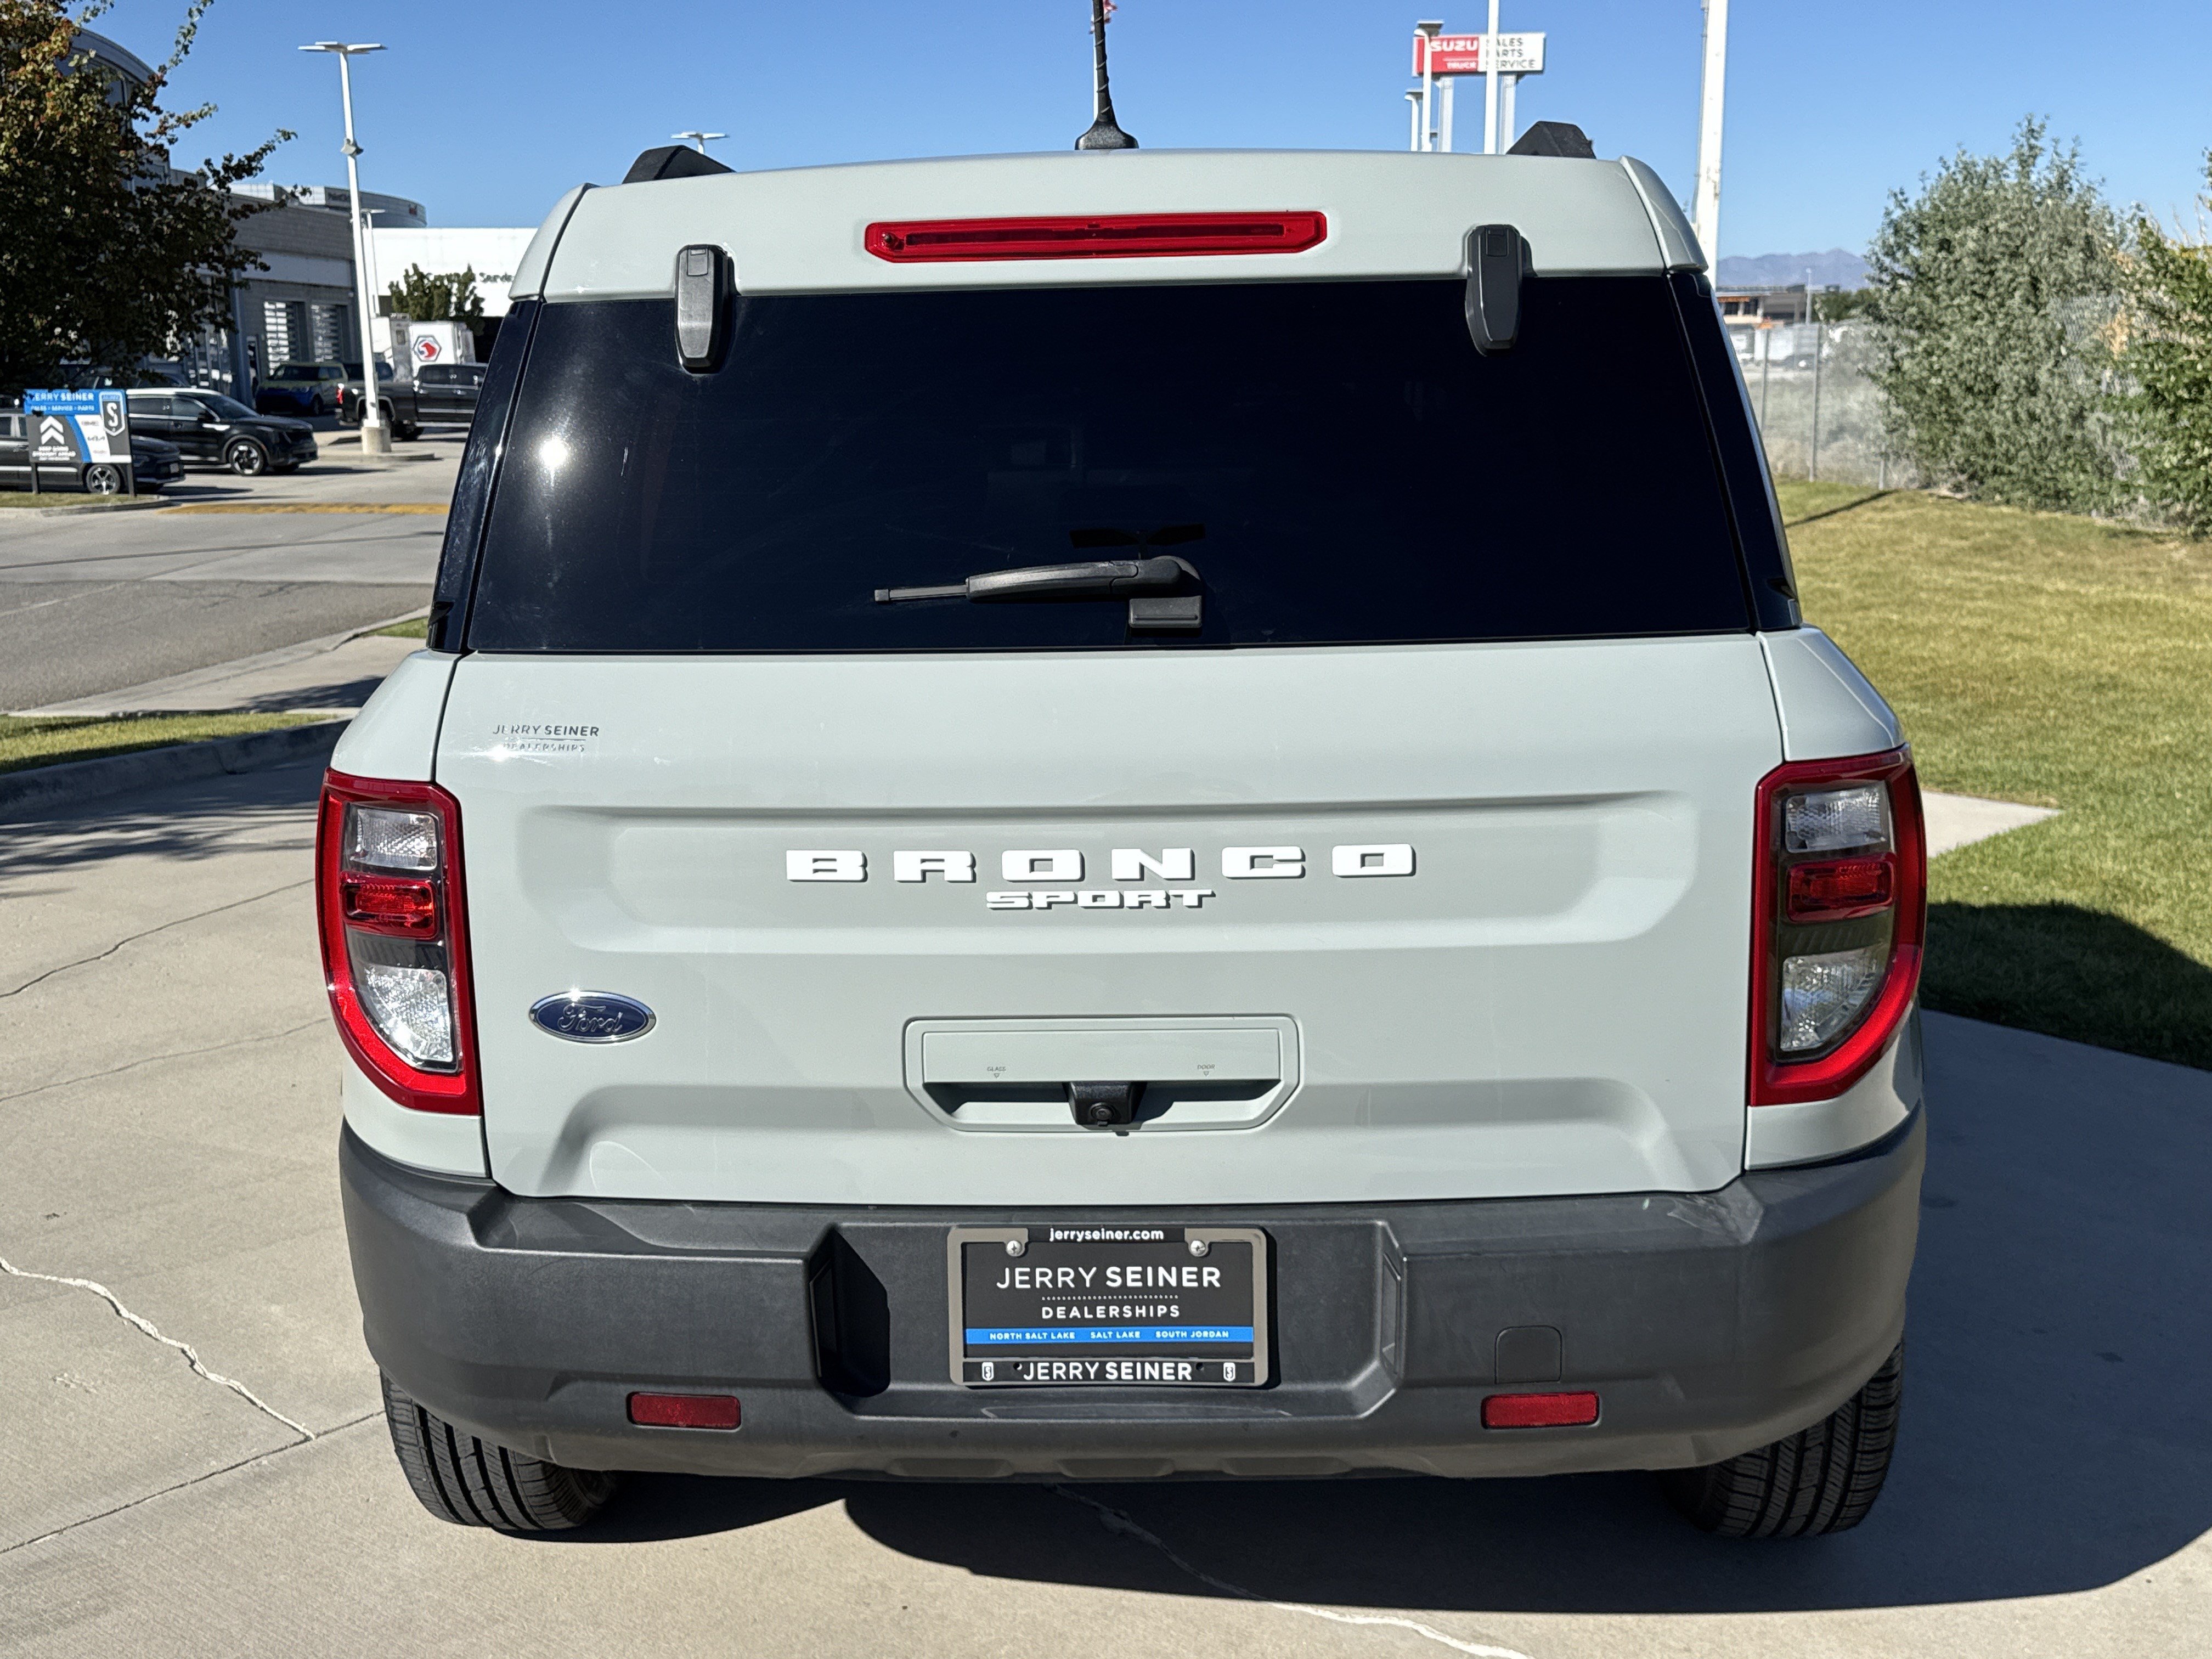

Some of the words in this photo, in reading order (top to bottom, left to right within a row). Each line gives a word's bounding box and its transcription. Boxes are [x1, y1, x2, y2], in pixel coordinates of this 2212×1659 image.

[1430, 40, 1478, 52] SUZU
[493, 724, 541, 735] JERRY
[544, 725, 599, 737] SEINER
[786, 843, 1417, 883] BRONCO
[986, 889, 1216, 911] SPORT
[557, 1003, 623, 1032] Ford
[1049, 1228, 1164, 1242] jerryseiner.com
[996, 1266, 1097, 1289] JERRY
[1105, 1266, 1221, 1288] SEINER
[1042, 1305, 1180, 1319] DEALERSHIPS
[989, 1332, 1022, 1341] NORTH
[1024, 1331, 1048, 1340] SALT
[1050, 1331, 1076, 1340] LAKE
[1090, 1331, 1114, 1339] SALT
[1115, 1330, 1141, 1339] LAKE
[1155, 1330, 1188, 1339] SOUTH
[1189, 1330, 1229, 1339] JORDAN
[1023, 1362, 1099, 1380] JERRY
[1105, 1361, 1193, 1380] SEINER
